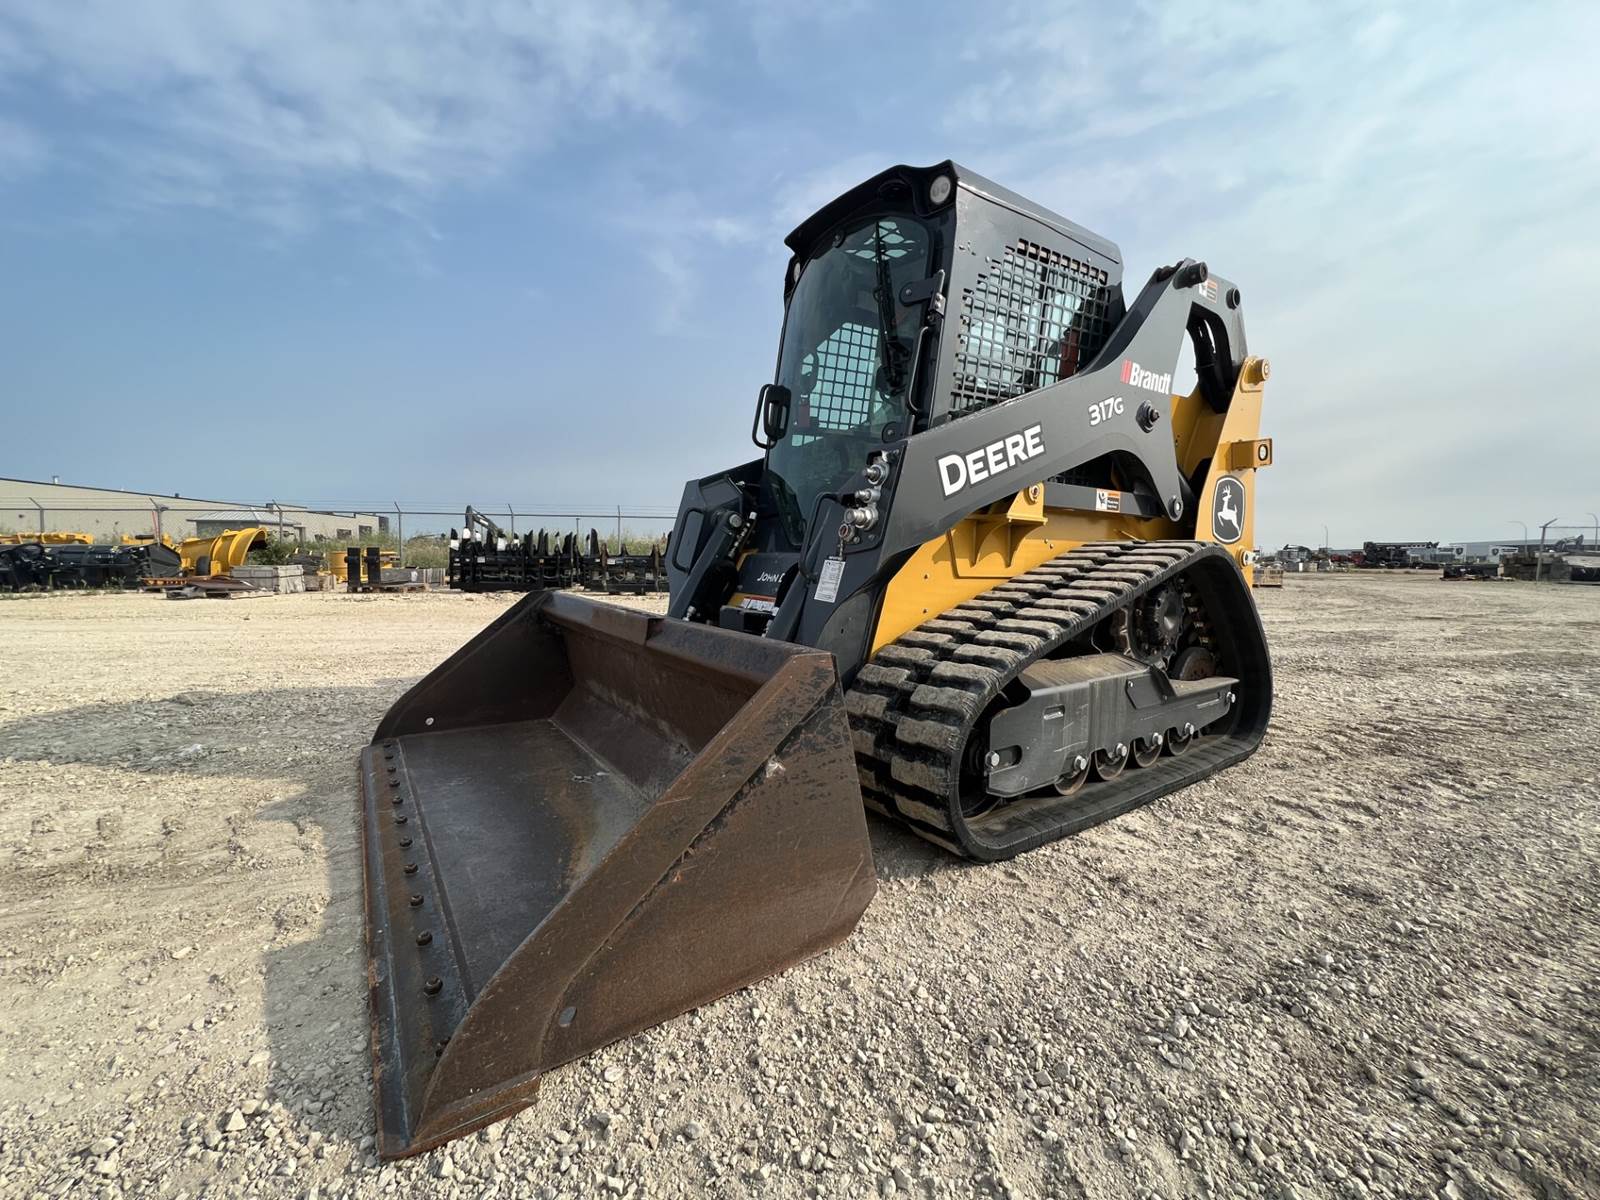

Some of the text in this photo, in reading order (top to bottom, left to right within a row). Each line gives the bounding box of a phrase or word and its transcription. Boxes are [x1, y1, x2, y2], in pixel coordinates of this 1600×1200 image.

[1129, 362, 1171, 395] Brandt
[1088, 397, 1124, 426] 317G
[937, 424, 1045, 497] DEERE
[757, 571, 780, 583] JOHN
